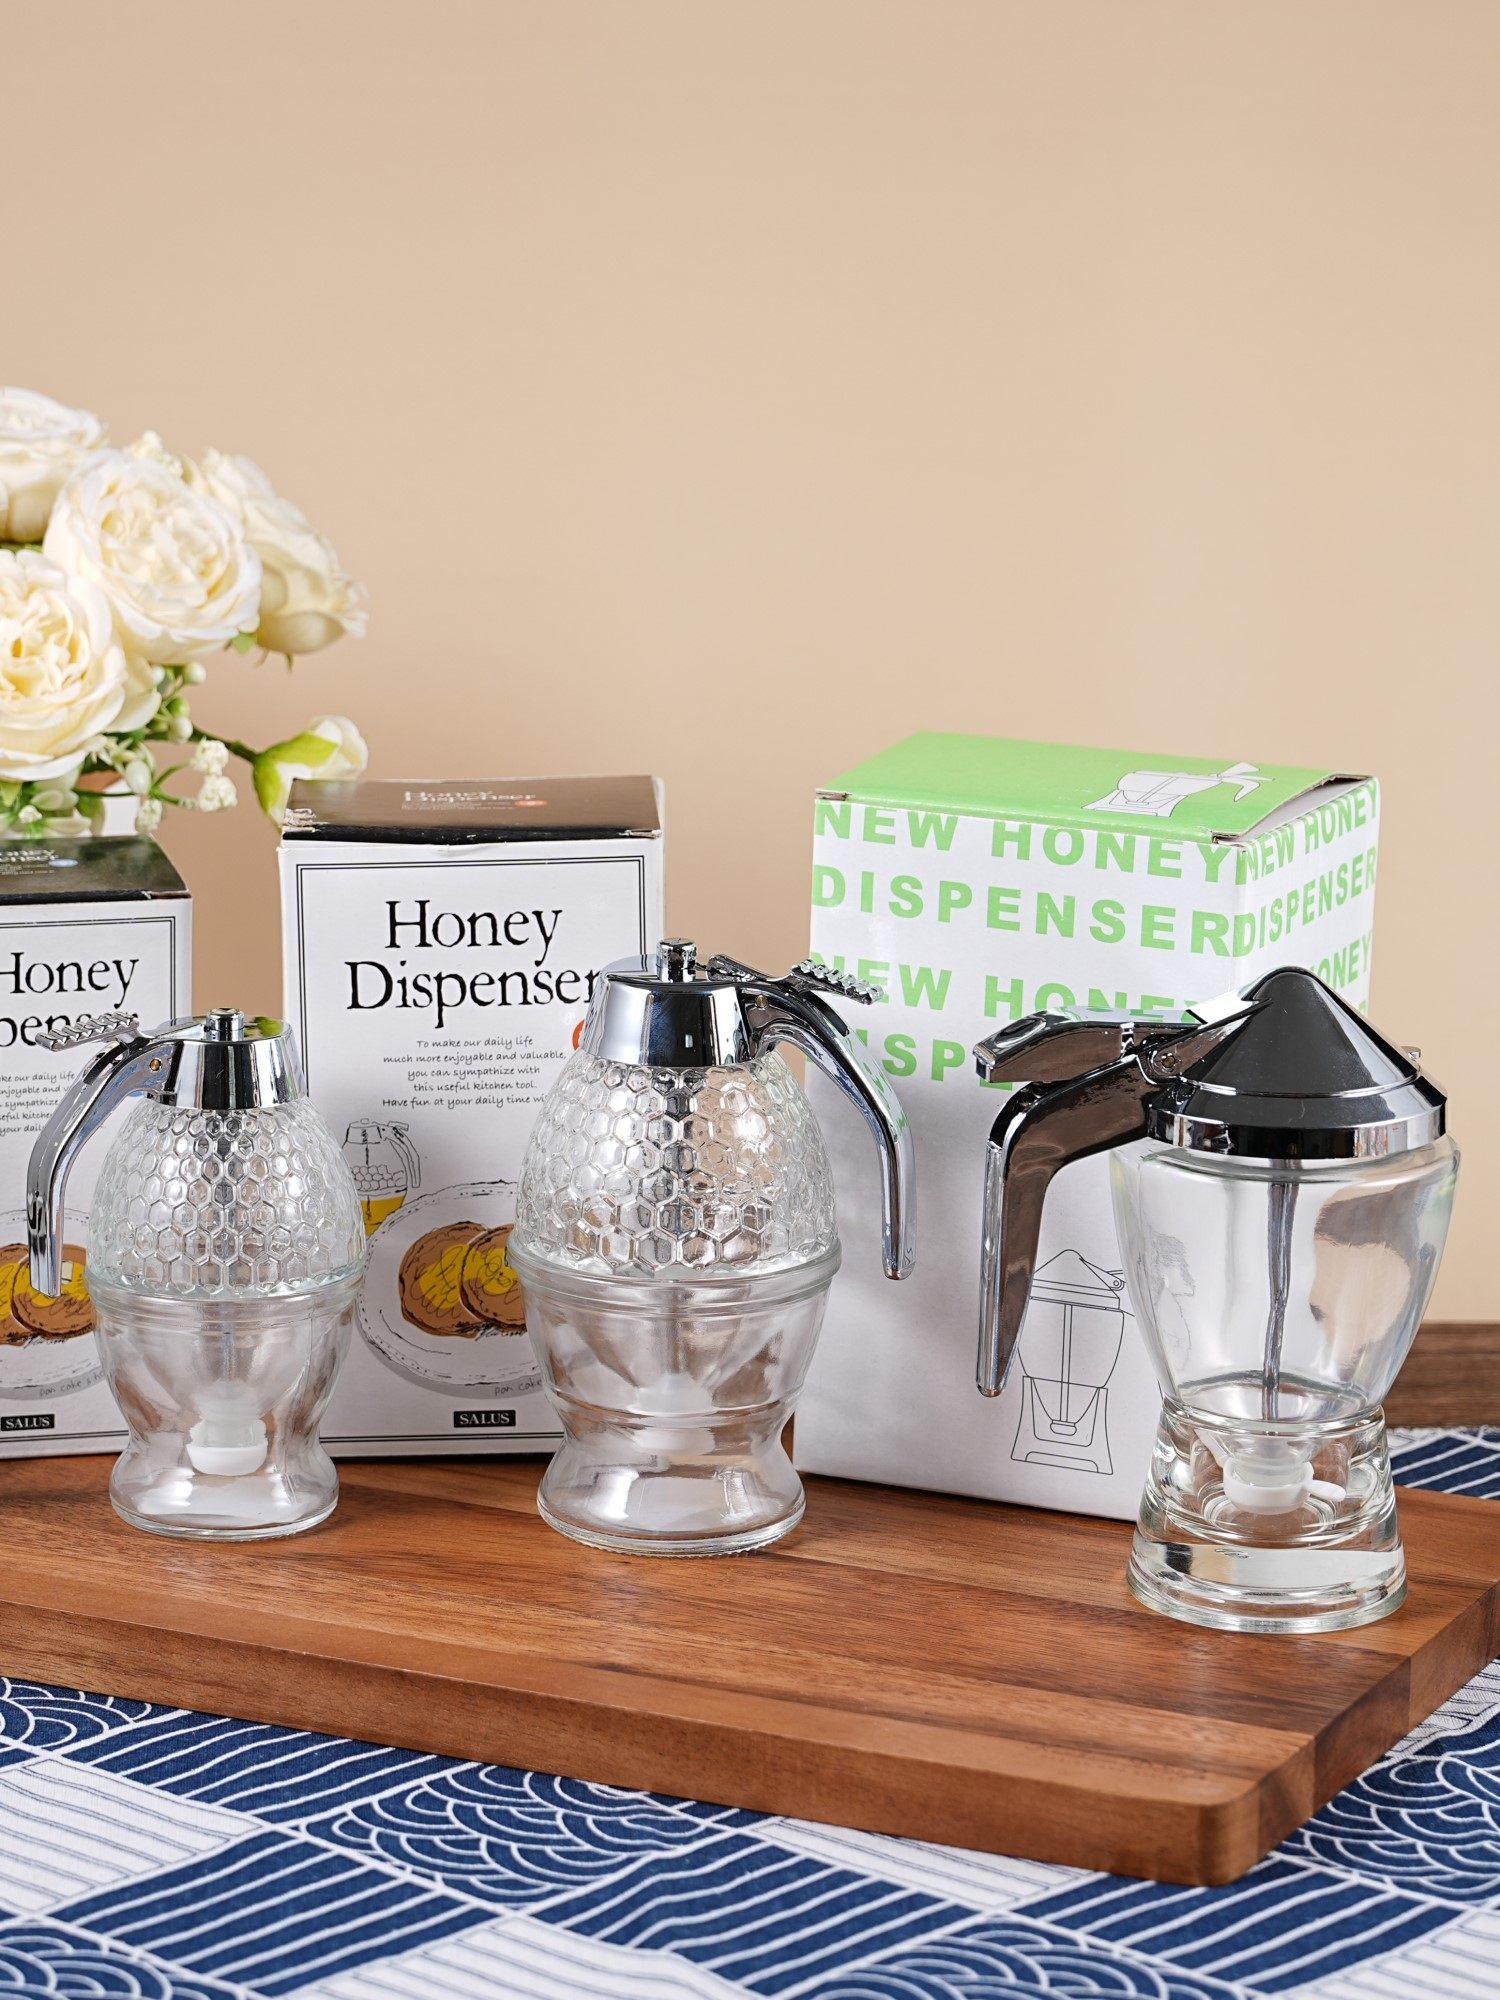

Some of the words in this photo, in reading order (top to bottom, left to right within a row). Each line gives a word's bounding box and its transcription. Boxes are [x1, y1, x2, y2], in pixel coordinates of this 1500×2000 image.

[1235, 823, 1295, 885] NEW
[1305, 780, 1377, 855] HONEY
[815, 804, 959, 852] NEW
[991, 821, 1231, 883] HONEY
[1232, 846, 1376, 958] DISPENSER
[811, 864, 1231, 958] DISPENSER
[385, 900, 563, 966] Honey
[344, 960, 600, 1029] Dispenser
[416, 1039, 429, 1048] To
[432, 1038, 461, 1048] make
[463, 1039, 480, 1048] our
[484, 1037, 512, 1050] daily
[515, 1036, 533, 1048] life
[383, 1052, 413, 1063] much
[416, 1054, 441, 1063] more
[444, 1052, 493, 1066] enjoyable
[496, 1052, 517, 1061] and
[32, 1072, 57, 1084] daily
[60, 1071, 75, 1080] life
[408, 1069, 428, 1081] you
[431, 1069, 450, 1077] can
[453, 1067, 515, 1081] sympathize
[517, 1066, 541, 1075] with
[0, 1085, 40, 1098] njoyable
[413, 1082, 434, 1092] this
[437, 1081, 470, 1094] useful
[473, 1080, 513, 1091] kitchen
[5, 1099, 59, 1111] sympathize
[382, 1097, 408, 1107] Have
[410, 1097, 431, 1109] fun
[434, 1097, 444, 1106] at
[447, 1098, 472, 1109] your
[475, 1095, 504, 1109] daily
[506, 1095, 530, 1105] time
[22, 1109, 53, 1120] kitche
[23, 1123, 44, 1132] dail
[5, 1416, 51, 1429] SALUS
[459, 1413, 510, 1426] SALUS
